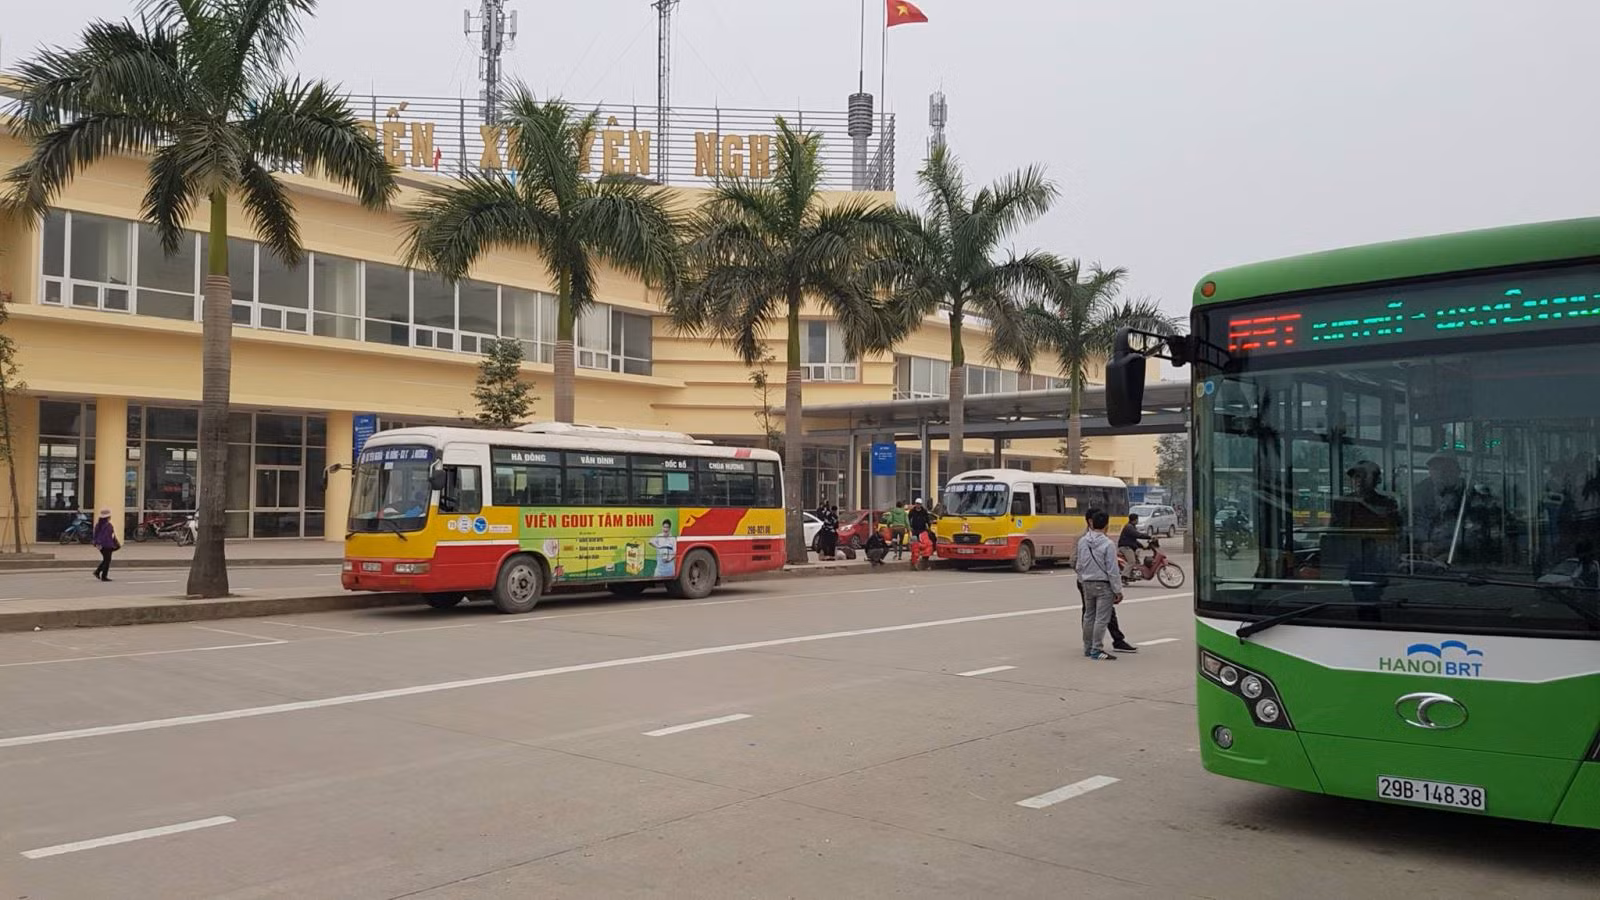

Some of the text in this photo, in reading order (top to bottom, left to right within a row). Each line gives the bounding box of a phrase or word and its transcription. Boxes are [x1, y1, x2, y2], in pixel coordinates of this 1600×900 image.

[694, 131, 806, 178] NGH
[525, 512, 654, 528] VIÊN GOUT TÂM BÌNH
[1379, 657, 1482, 677] HANOI BRT
[1381, 778, 1482, 807] 29B-148.38
